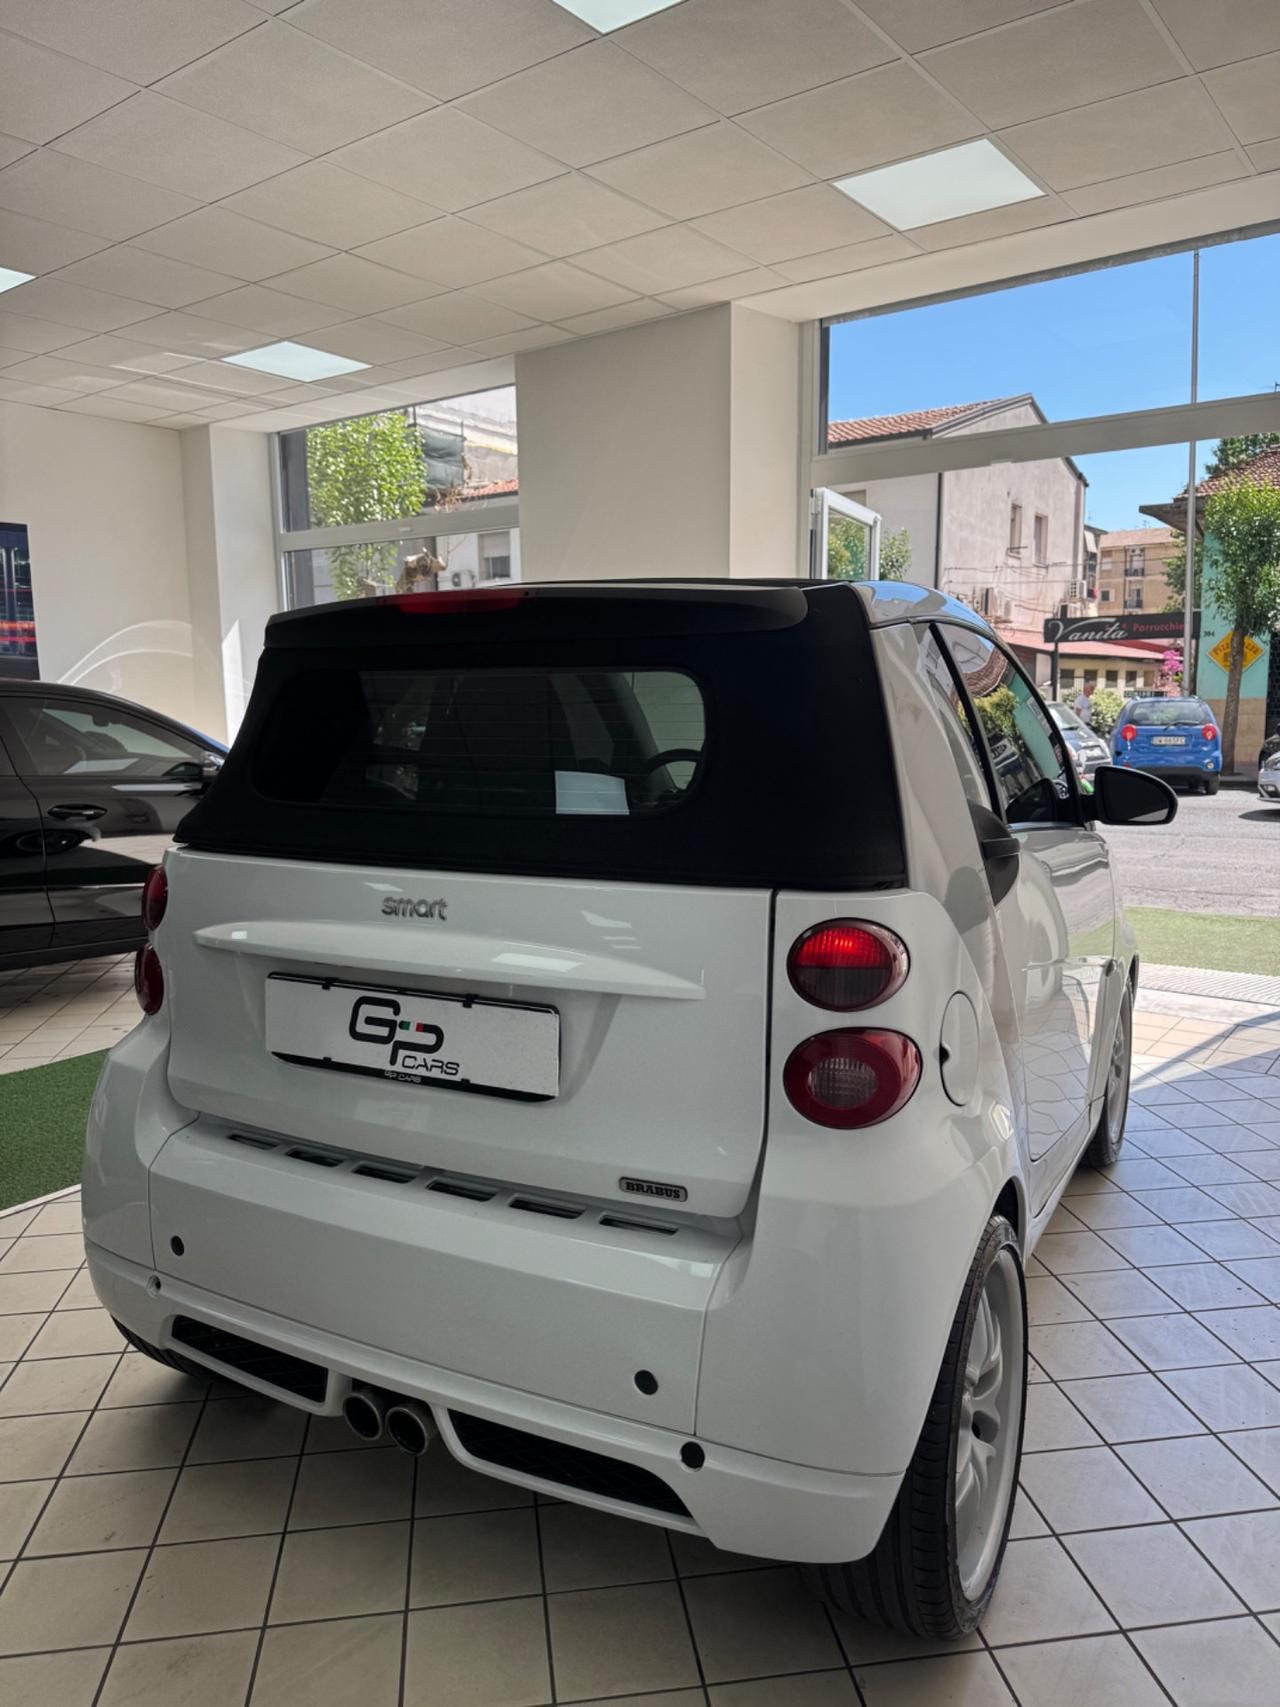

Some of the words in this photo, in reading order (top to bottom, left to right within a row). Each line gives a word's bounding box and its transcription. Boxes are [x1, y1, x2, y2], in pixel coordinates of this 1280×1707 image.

[381, 896, 448, 921] smart
[402, 1055, 460, 1076] CARS
[625, 1181, 681, 1199] BRABUS
